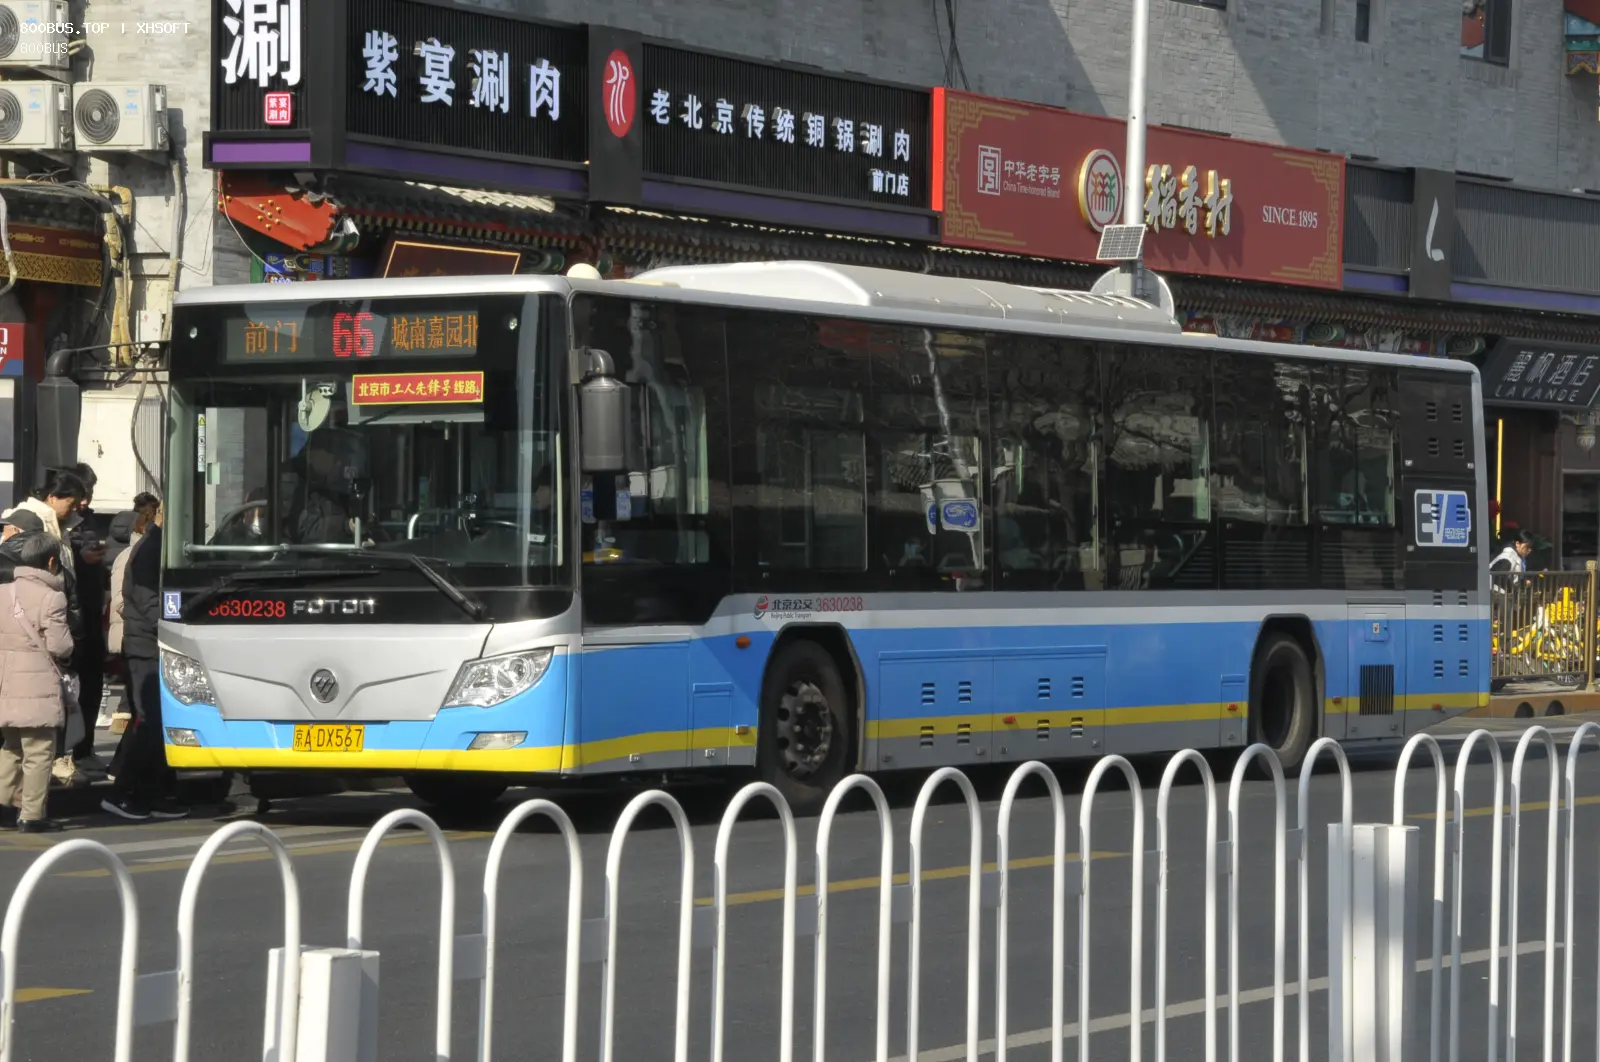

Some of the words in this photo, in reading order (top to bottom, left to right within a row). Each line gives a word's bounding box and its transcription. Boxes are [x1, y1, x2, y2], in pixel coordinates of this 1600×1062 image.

[221, 0, 301, 87] 涮
[362, 29, 561, 121] 紫宴涮肉
[650, 88, 910, 162] 老北京传统铜锅涮肉
[870, 169, 909, 196] 前门店
[1004, 160, 1060, 185] 中华老字号
[1144, 164, 1233, 238] 稻香村
[244, 321, 298, 354] 前门
[332, 312, 374, 357] 66
[391, 314, 479, 351] 城南嘉园北
[1495, 384, 1580, 402] LAVANDE
[293, 599, 374, 614] FOTON
[771, 599, 813, 611] 北京公交
[815, 596, 863, 612] 3630238
[295, 728, 363, 748] 京A·DX567
